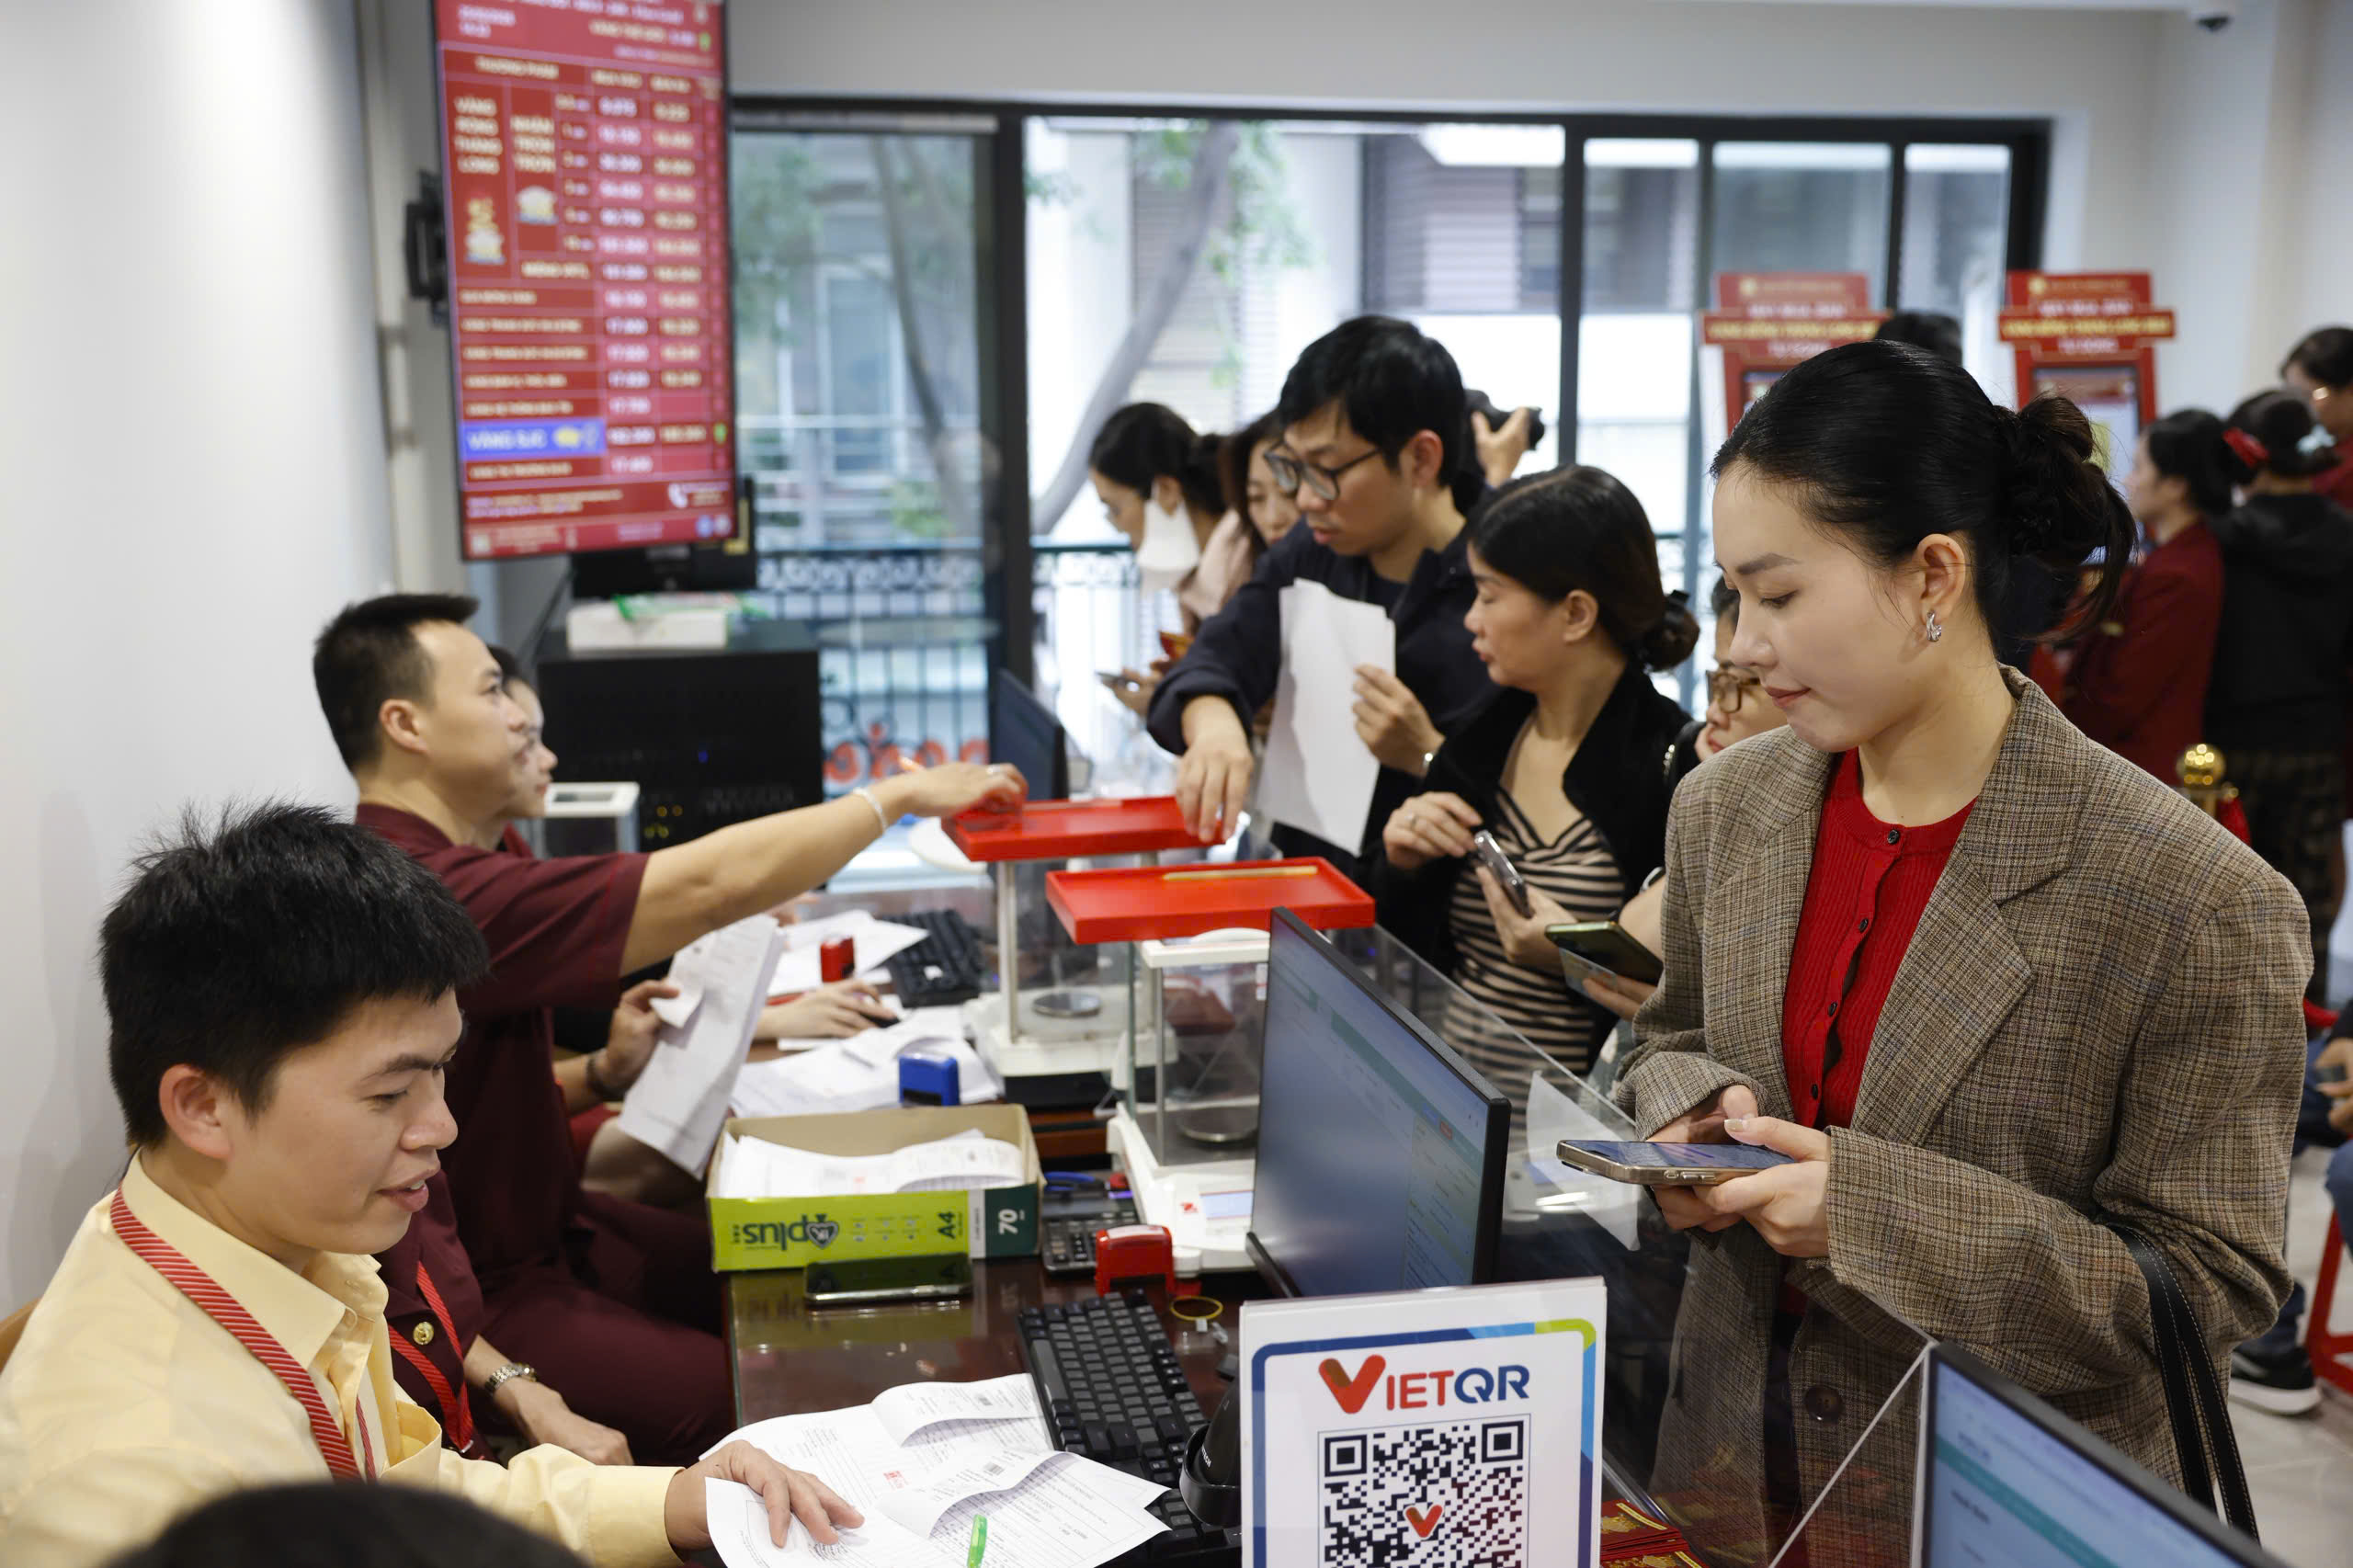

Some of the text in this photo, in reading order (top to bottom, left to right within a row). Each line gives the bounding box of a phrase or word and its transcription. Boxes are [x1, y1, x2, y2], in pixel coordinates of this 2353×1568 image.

[743, 1214, 808, 1251] plus
[938, 1211, 956, 1240] A4
[998, 1209, 1018, 1235] 70
[1318, 1354, 1530, 1414] VIETQR
